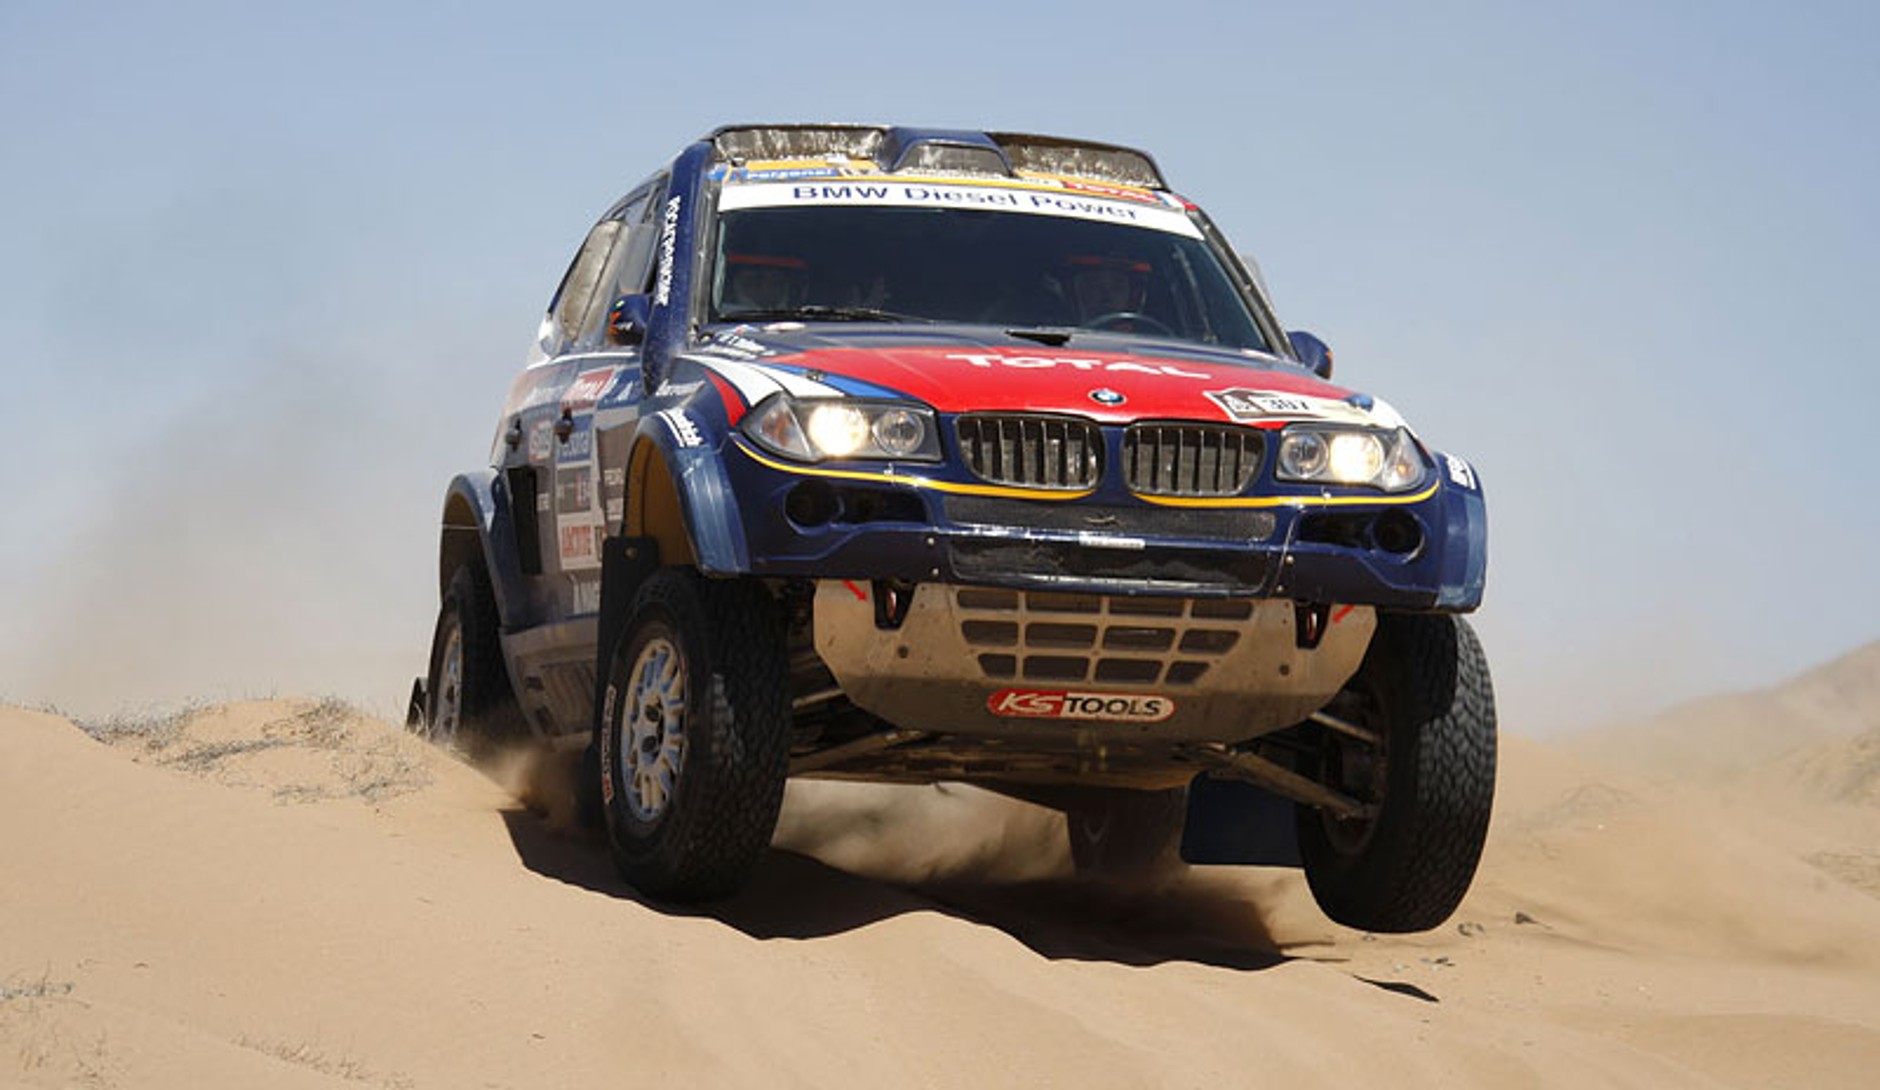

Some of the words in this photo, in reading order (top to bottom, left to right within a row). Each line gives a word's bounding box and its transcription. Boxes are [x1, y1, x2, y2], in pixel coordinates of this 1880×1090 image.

[793, 187, 889, 200] BMW
[904, 187, 1018, 206] Diesel
[1029, 195, 1138, 220] Power
[944, 353, 1212, 380] TOTAL
[997, 692, 1064, 713] KS
[1063, 696, 1163, 716] TOOLS
